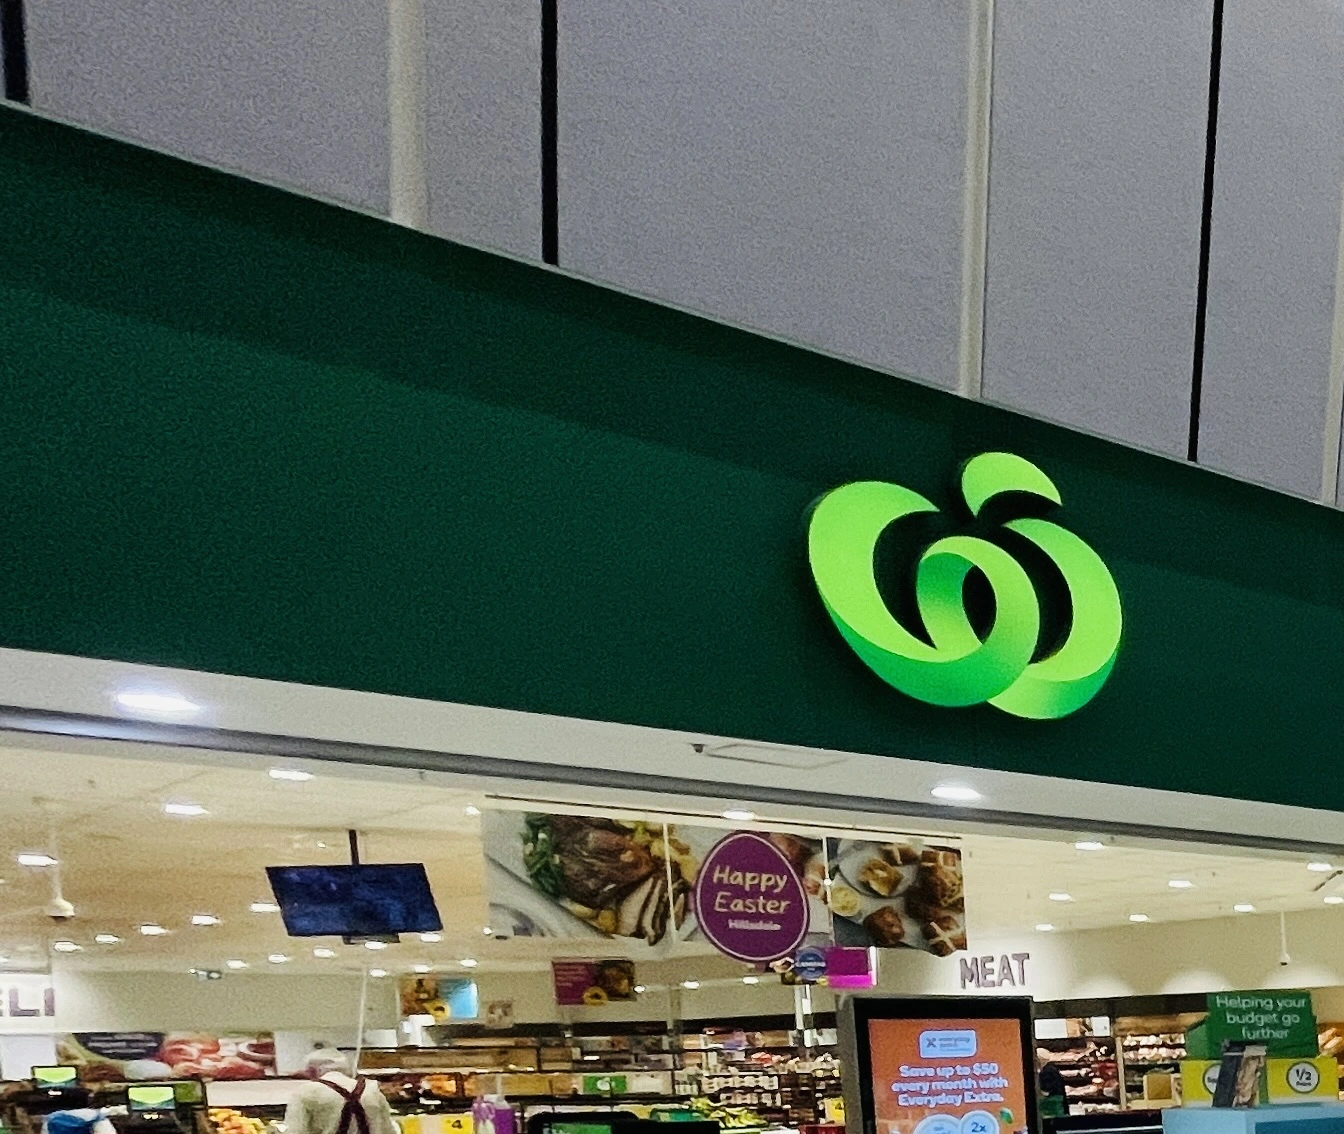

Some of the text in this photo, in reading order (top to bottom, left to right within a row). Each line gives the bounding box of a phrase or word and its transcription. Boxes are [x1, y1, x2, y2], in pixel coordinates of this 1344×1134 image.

[712, 865, 788, 893] Happy
[714, 891, 791, 915] Easter
[960, 953, 1030, 989] MEAT
[0, 986, 56, 1017] LI
[1216, 995, 1307, 1012] Helping your
[1226, 1011, 1301, 1027] budget go
[1241, 1027, 1290, 1041] further
[899, 1065, 935, 1077] Save
[936, 1066, 955, 1078] up
[955, 1065, 971, 1076] to
[1296, 1068, 1312, 1081] 1/2
[891, 1077, 1009, 1095] every month with
[898, 1092, 963, 1108] Everyday
[971, 1121, 987, 1133] 2x
